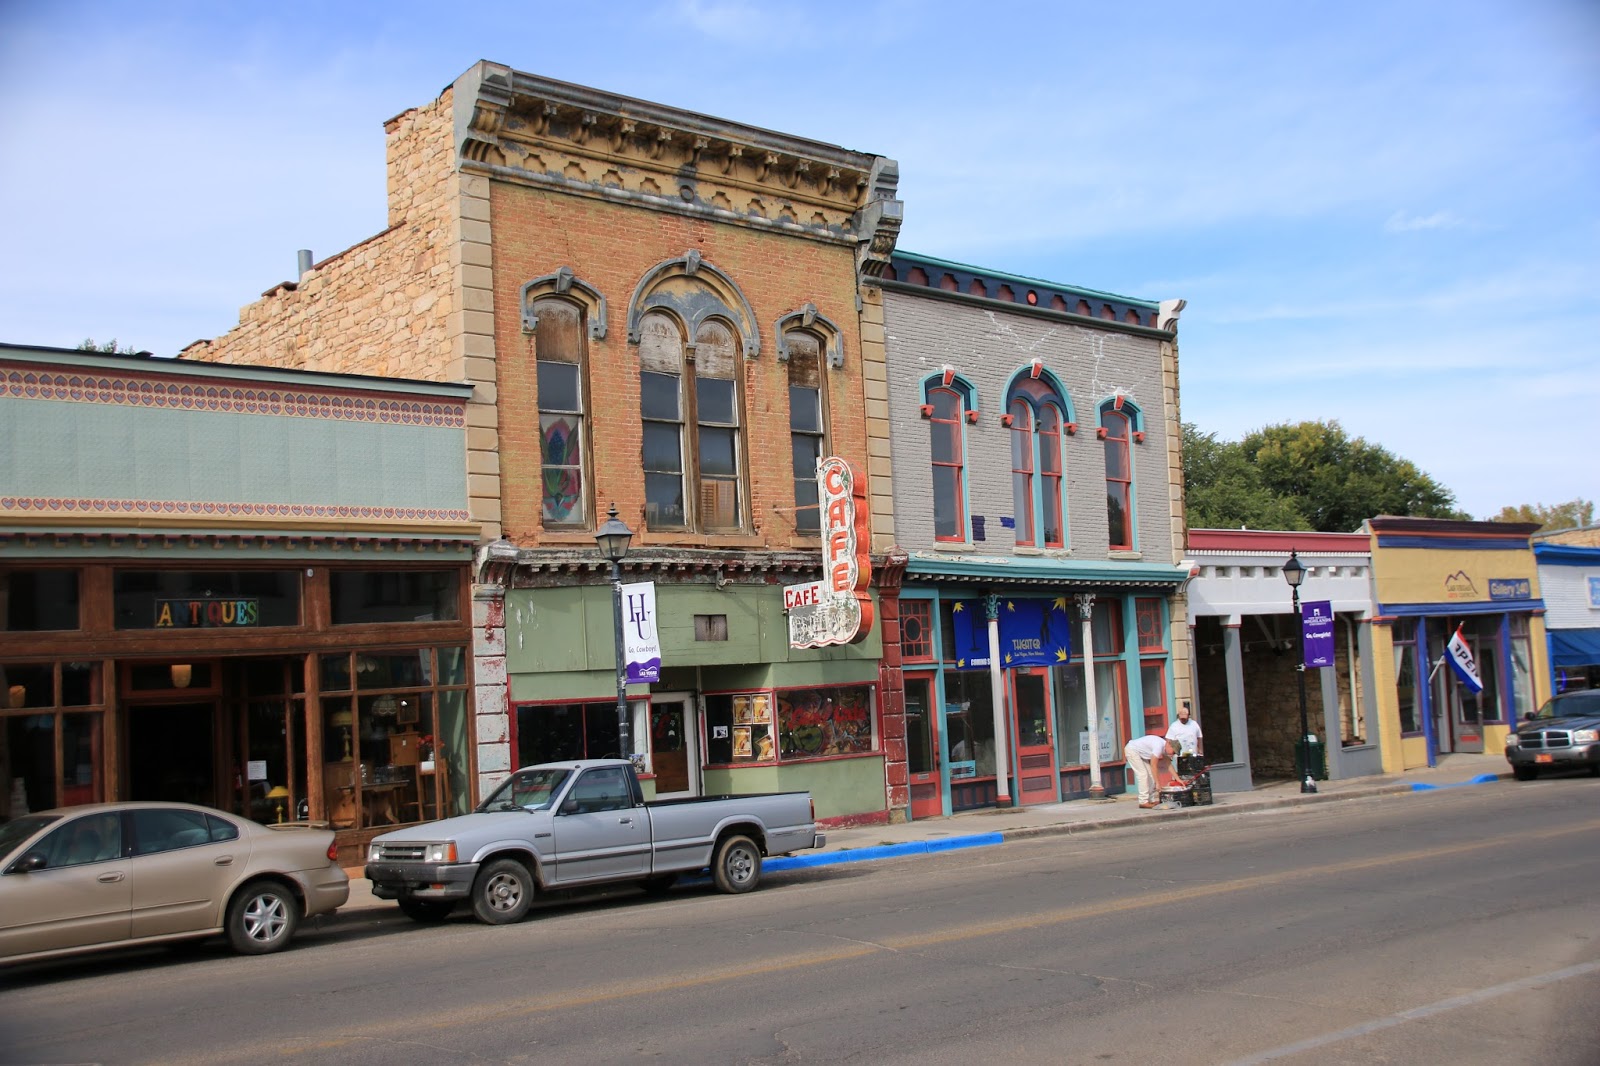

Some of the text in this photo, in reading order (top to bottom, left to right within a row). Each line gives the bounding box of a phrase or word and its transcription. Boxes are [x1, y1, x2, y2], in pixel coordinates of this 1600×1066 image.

[826, 466, 850, 592] CAFE
[785, 585, 819, 608] CAFE
[1491, 582, 1515, 597] Gallery
[157, 601, 257, 627] ANTIQUES
[1012, 638, 1041, 650] THEATER
